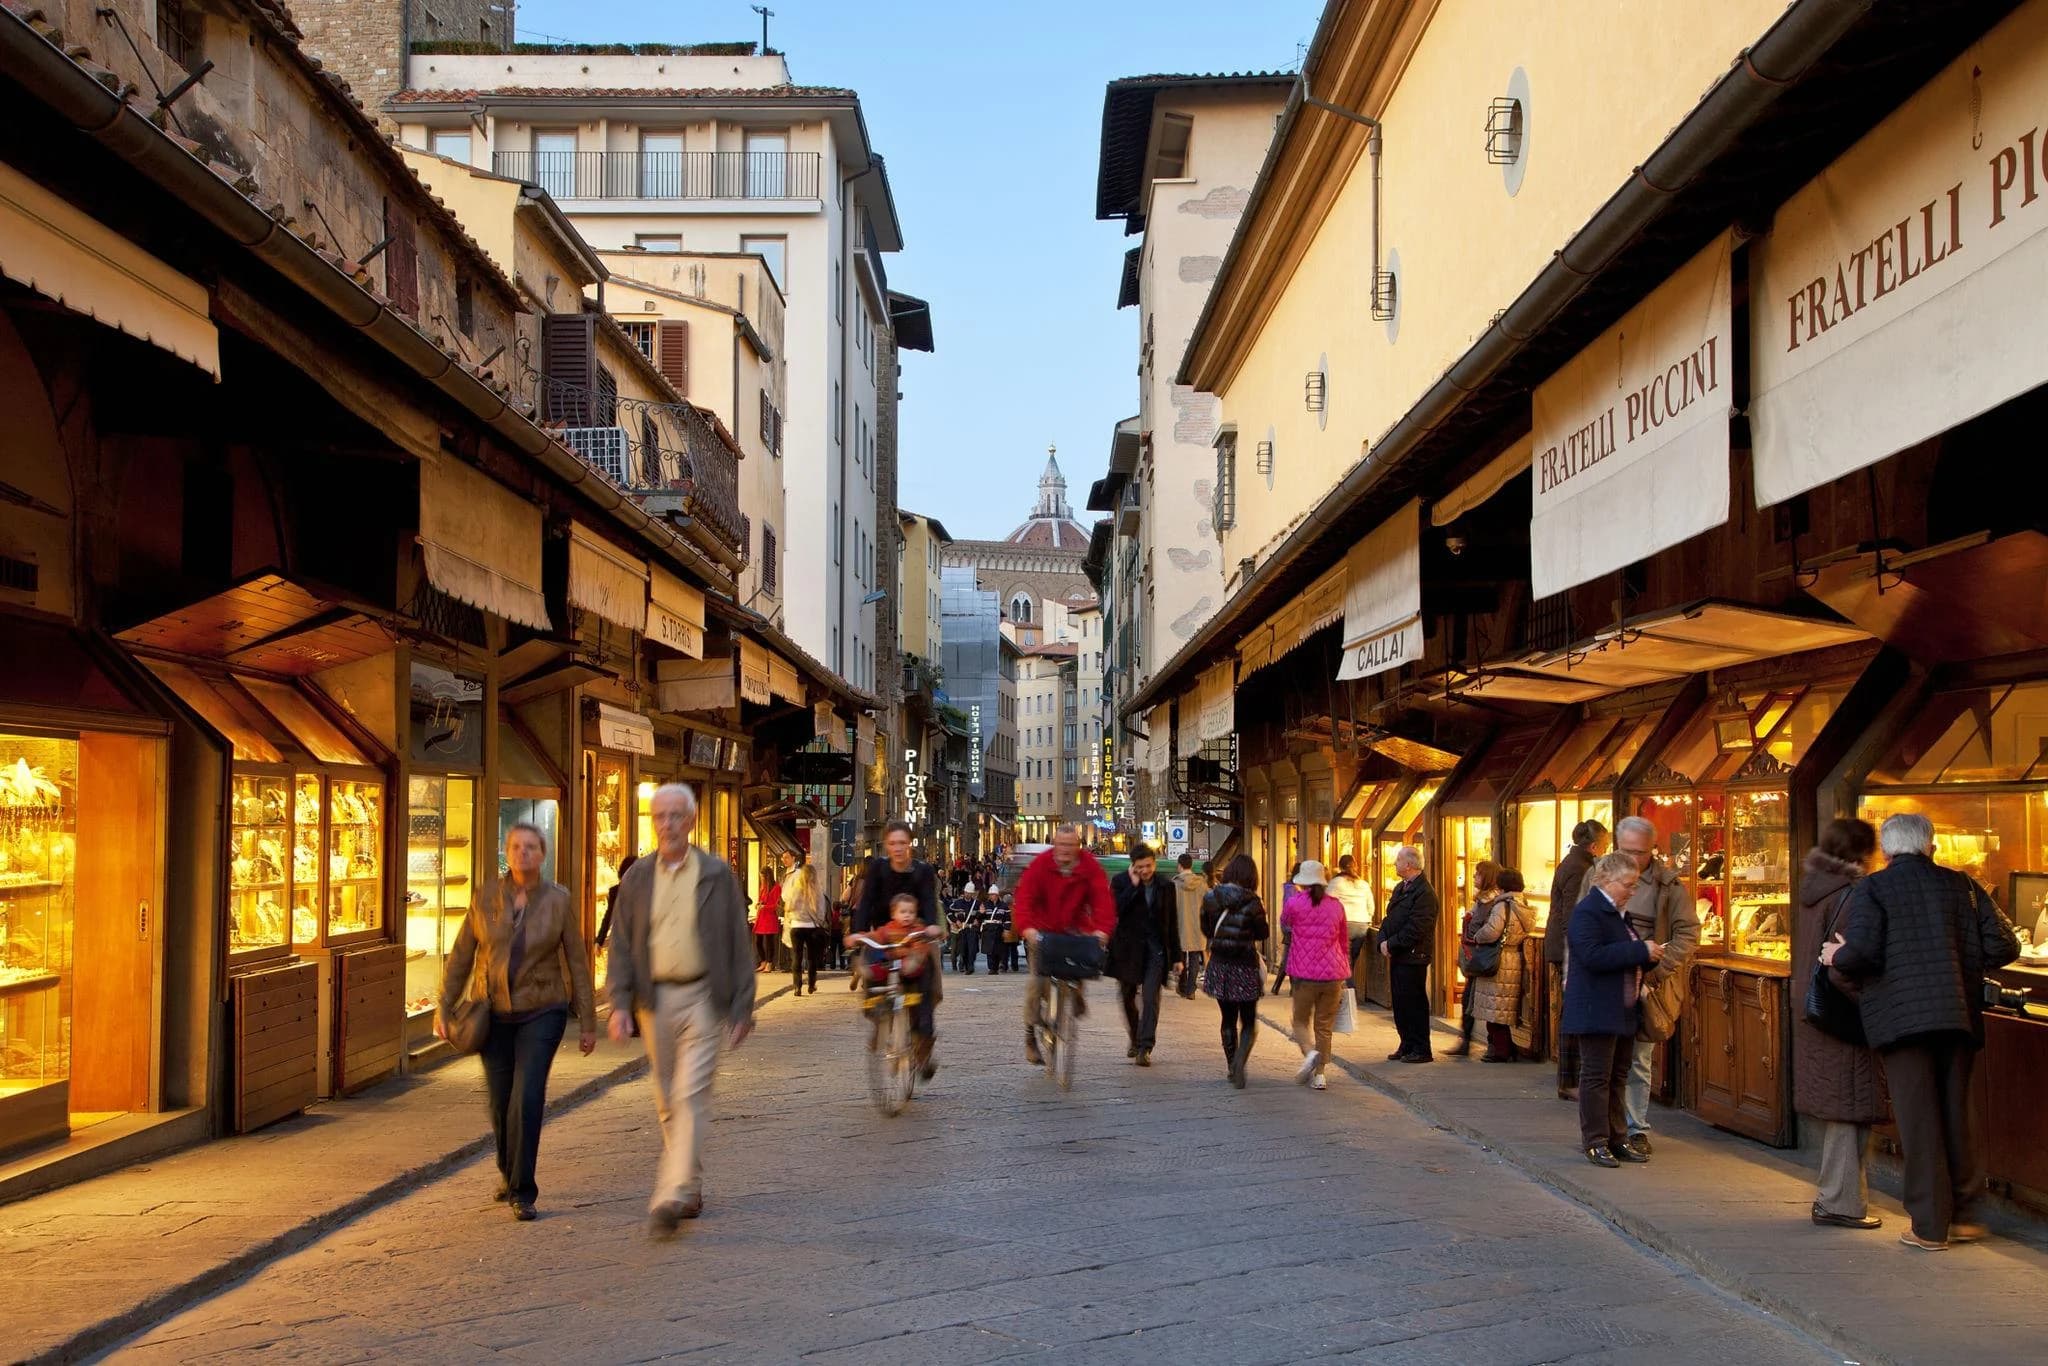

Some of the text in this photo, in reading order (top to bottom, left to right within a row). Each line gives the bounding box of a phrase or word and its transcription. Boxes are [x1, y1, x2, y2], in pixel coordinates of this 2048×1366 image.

[1786, 126, 2048, 353] FRATELLI PI
[1539, 335, 1718, 495] FRATELLI PICCINI
[1357, 631, 1404, 671] CALLAI
